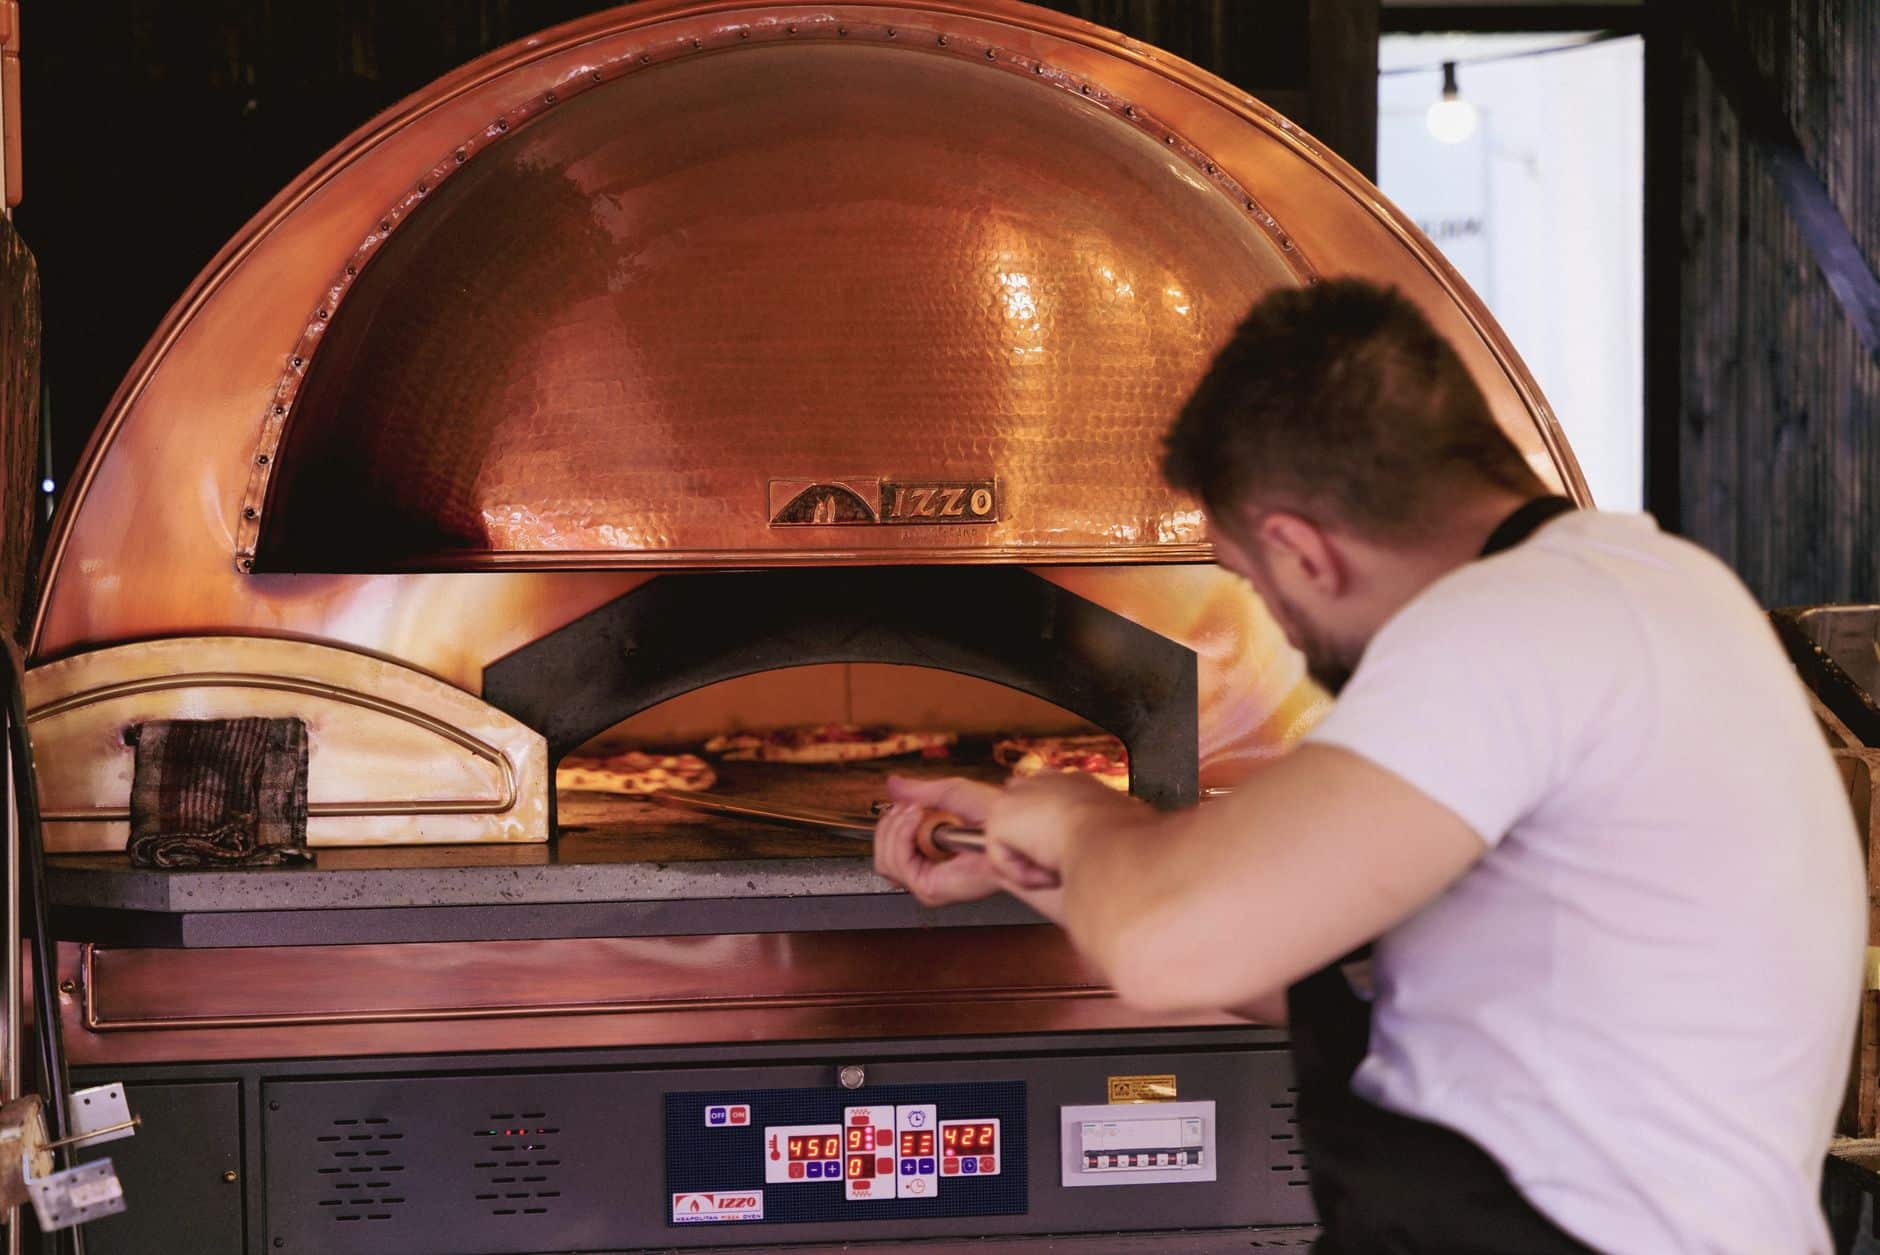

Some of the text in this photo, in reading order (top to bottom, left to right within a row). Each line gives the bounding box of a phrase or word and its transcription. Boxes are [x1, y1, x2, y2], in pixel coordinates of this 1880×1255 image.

[891, 487, 993, 517] IZZO
[711, 1112, 725, 1120] OFF
[945, 1127, 992, 1145] 422
[790, 1138, 838, 1157] 450
[718, 1197, 757, 1209] IZZO
